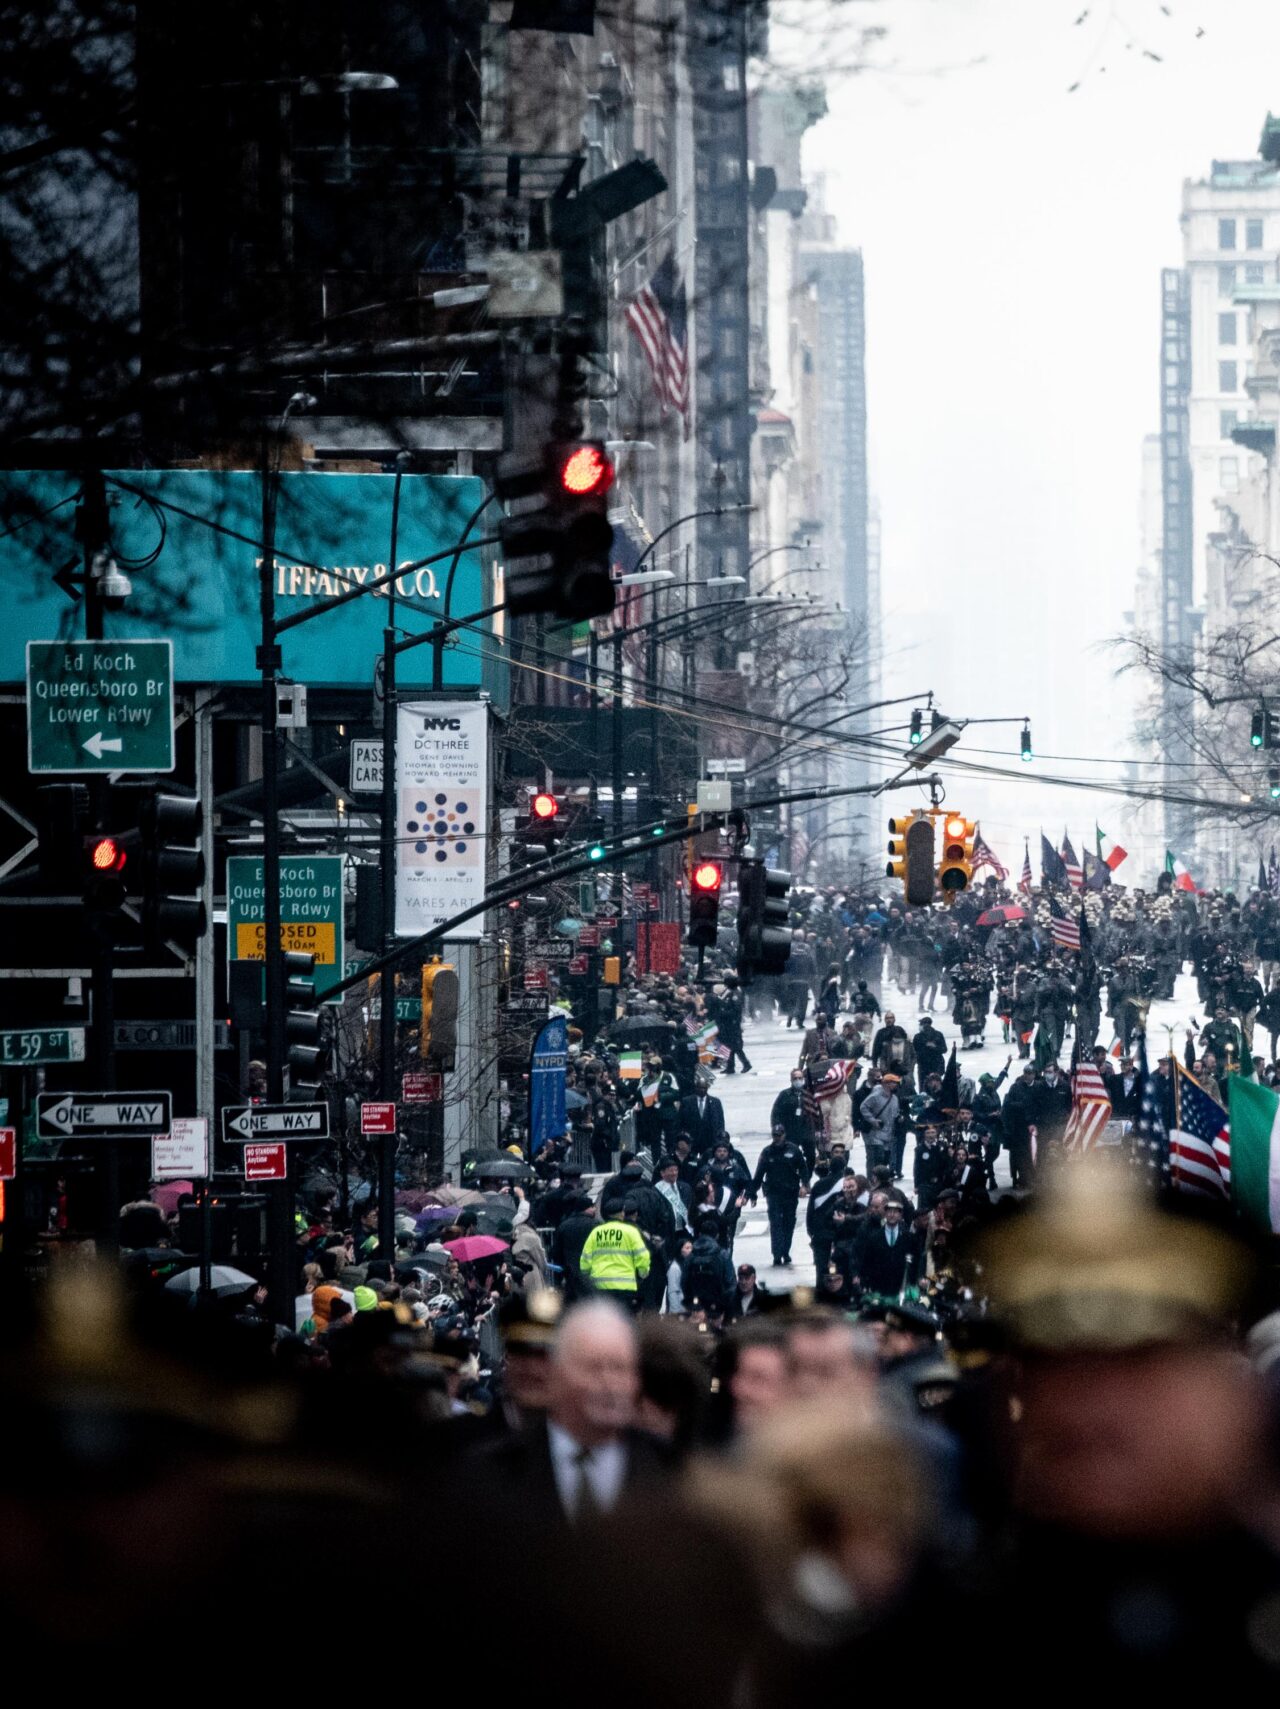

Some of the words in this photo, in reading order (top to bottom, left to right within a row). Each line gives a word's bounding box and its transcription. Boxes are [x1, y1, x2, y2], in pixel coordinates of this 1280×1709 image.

[64, 653, 84, 671] Ed
[93, 653, 137, 671] Koch
[36, 680, 138, 699] Queensboro
[146, 680, 164, 697] Br
[49, 706, 100, 723] Lower
[108, 705, 152, 726] Rdwy
[424, 718, 461, 731] NYC
[414, 740, 432, 750] DC
[434, 740, 470, 750] THREE
[356, 767, 384, 782] CARS
[280, 866, 315, 881] Koch
[233, 885, 318, 900] Queesboro
[323, 885, 337, 898] Br
[405, 898, 445, 909] YARES
[450, 897, 476, 909] ART
[240, 903, 285, 919] Uppr
[291, 903, 331, 919] Rdwy
[255, 925, 317, 939] COSED
[396, 1000, 411, 1018] 57
[2, 1035, 14, 1059] E
[20, 1033, 42, 1059] 59
[49, 1032, 65, 1047] ST
[55, 1107, 95, 1124] ONE
[117, 1106, 158, 1123] WAY
[239, 1115, 269, 1130] ONE
[283, 1114, 314, 1128] WAY
[596, 1229, 623, 1242] NYPD
